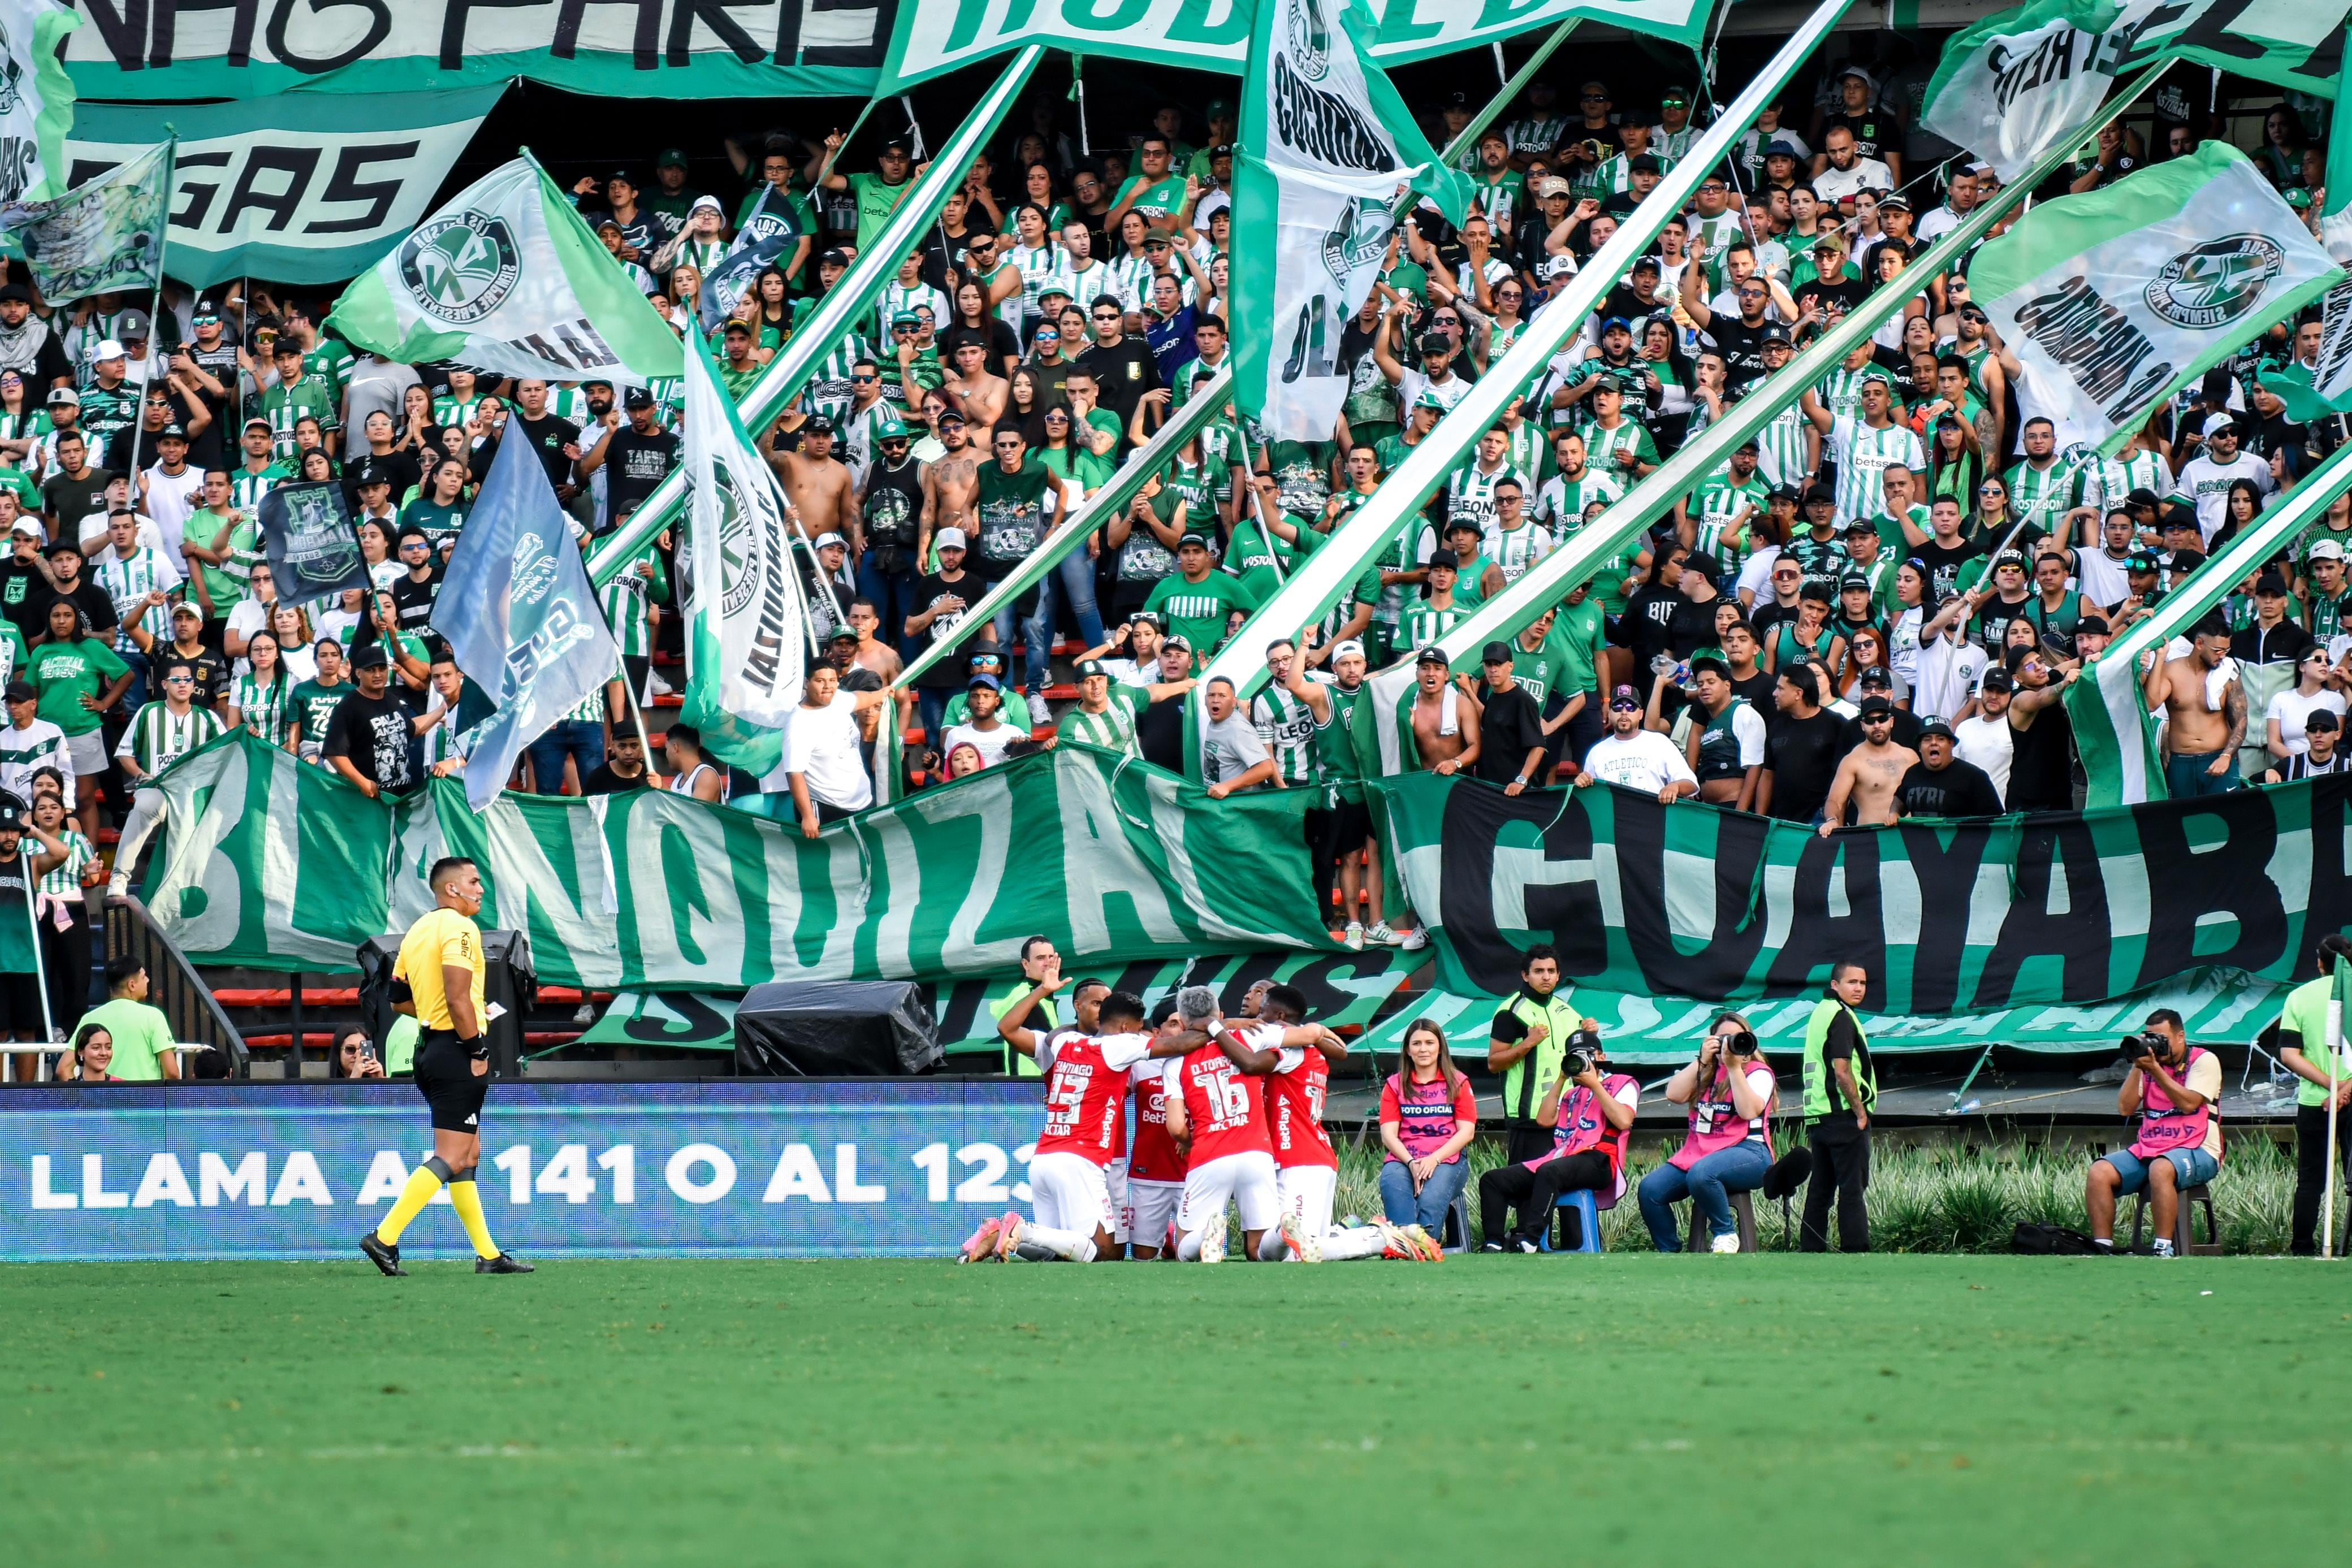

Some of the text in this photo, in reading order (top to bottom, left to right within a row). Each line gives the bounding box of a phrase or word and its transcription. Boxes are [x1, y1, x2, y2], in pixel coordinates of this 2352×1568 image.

[1545, 181, 1567, 189] BOSS
[863, 206, 889, 218] bets
[1855, 457, 1889, 469] betss
[1242, 555, 1291, 568] POSTON
[1802, 573, 1839, 582] etsson
[113, 596, 148, 614] betsso
[370, 711, 404, 731] PALA
[375, 721, 407, 739] ANCHA
[1279, 720, 1313, 740] LEO
[158, 754, 179, 768] POST
[1603, 757, 1648, 774] ATLETICO
[461, 932, 470, 958] Kalle
[1193, 1067, 1250, 1122] 16
[1400, 1104, 1453, 1115] FOTO OFICIAL
[1099, 1108, 1117, 1149] BetPlay
[1279, 1107, 1291, 1151] BetPlay
[32, 1151, 333, 1210] LLAMA
[494, 1144, 635, 1205] 141
[665, 1143, 737, 1204] O
[762, 1143, 886, 1203] AL
